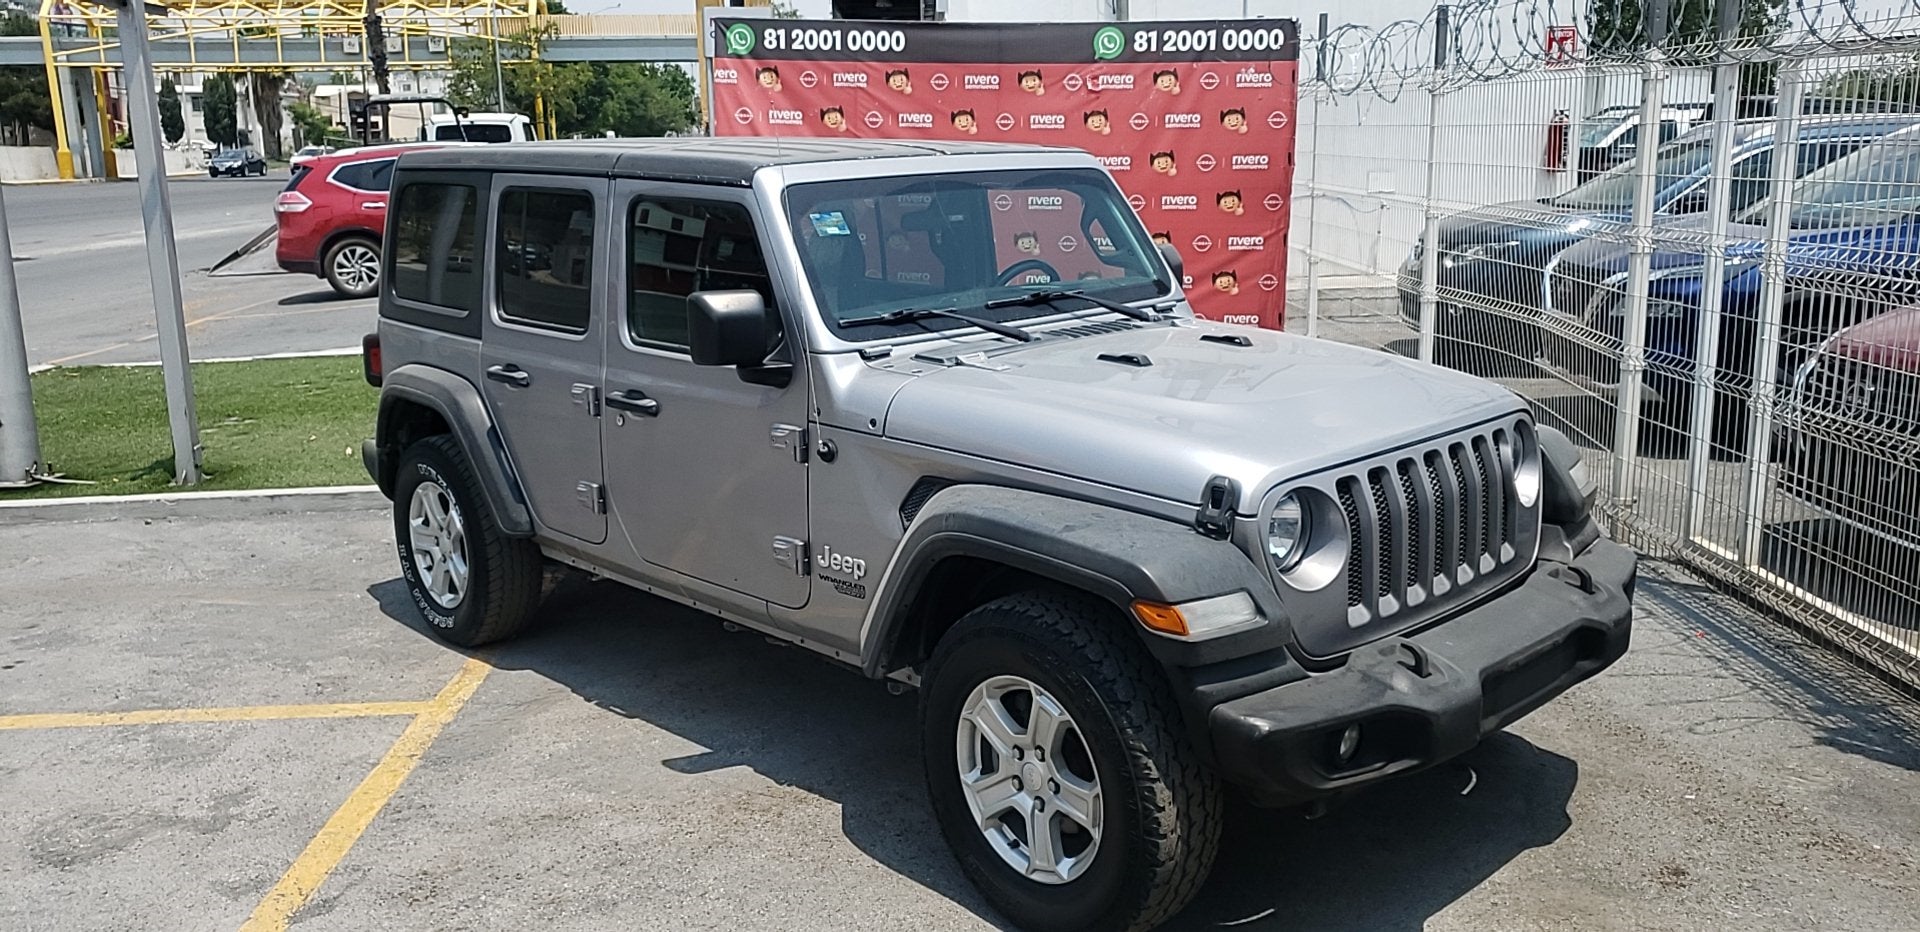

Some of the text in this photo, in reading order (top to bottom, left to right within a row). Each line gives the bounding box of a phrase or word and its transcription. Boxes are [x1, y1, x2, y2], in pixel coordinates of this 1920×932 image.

[763, 28, 906, 52] 81 2001 0000
[1133, 28, 1285, 52] 81 2001 0000
[833, 72, 868, 82] rivero
[965, 75, 1000, 85] rivero
[1099, 74, 1134, 84] rivero
[1236, 72, 1273, 82] rivero
[768, 109, 803, 120] rivero
[899, 113, 933, 123] rivero
[1030, 114, 1065, 124] rivero
[1165, 113, 1201, 123] rivero
[1232, 155, 1269, 165] rivero
[1028, 196, 1063, 205] rivero
[1161, 195, 1197, 205] rivero
[1228, 236, 1264, 246] rivero
[1224, 314, 1259, 324] rivero
[817, 545, 867, 580] Jeep
[818, 573, 866, 588] WRANGLER
